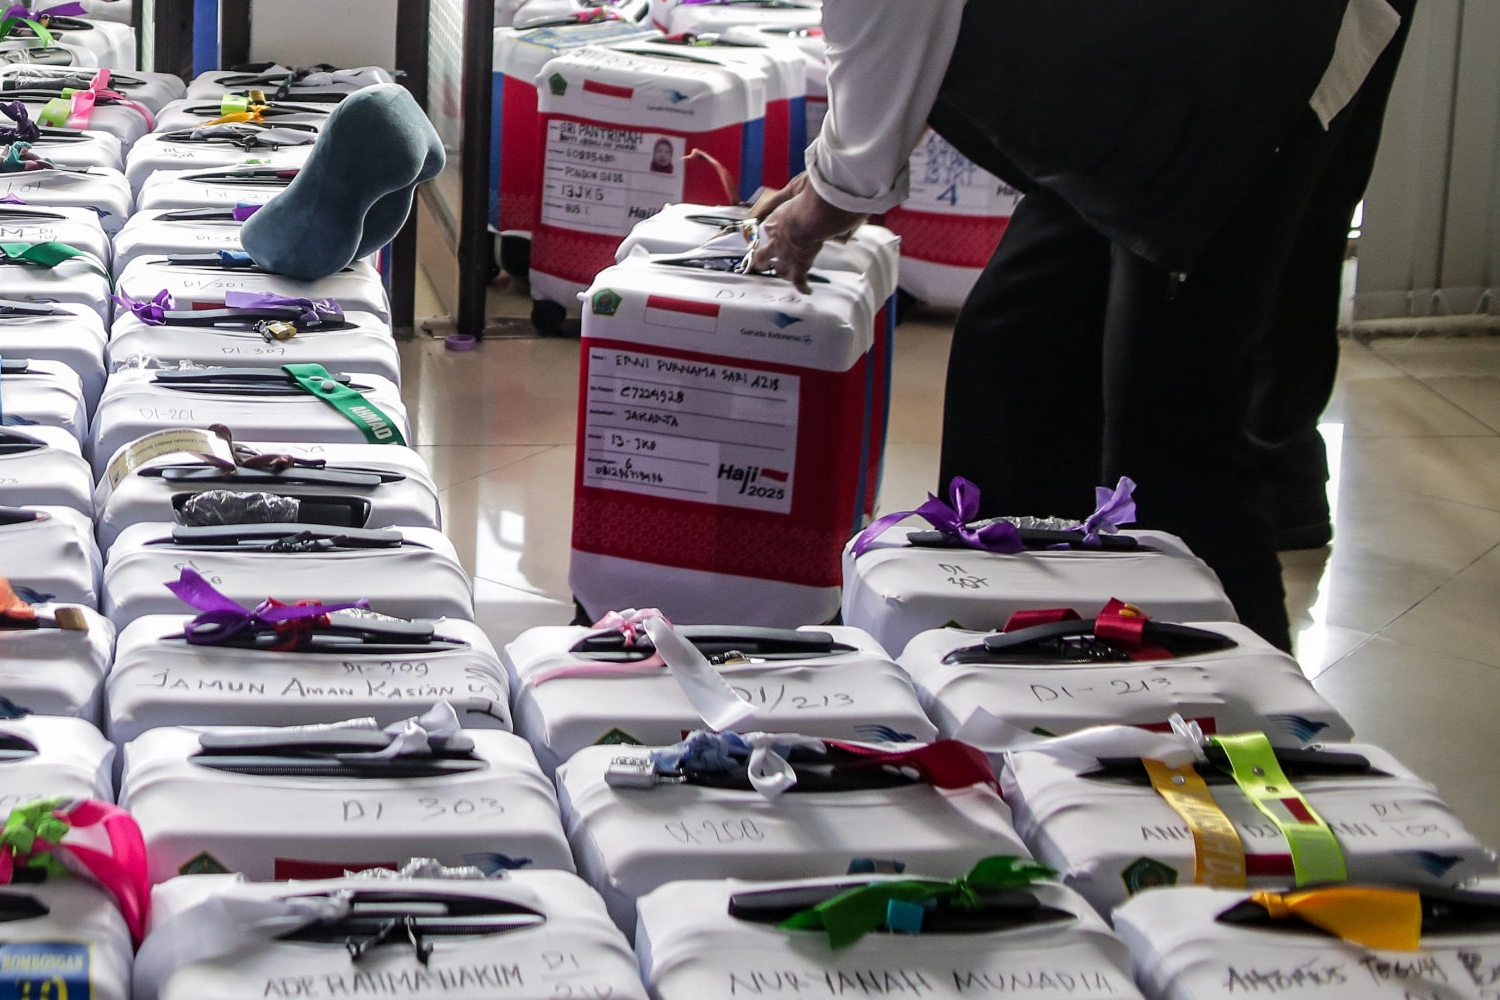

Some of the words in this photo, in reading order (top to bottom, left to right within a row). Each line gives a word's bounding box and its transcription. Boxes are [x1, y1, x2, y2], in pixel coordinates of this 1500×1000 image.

[347, 405, 394, 440] AHMAD
[717, 462, 760, 495] Haji
[748, 484, 786, 500] 2025
